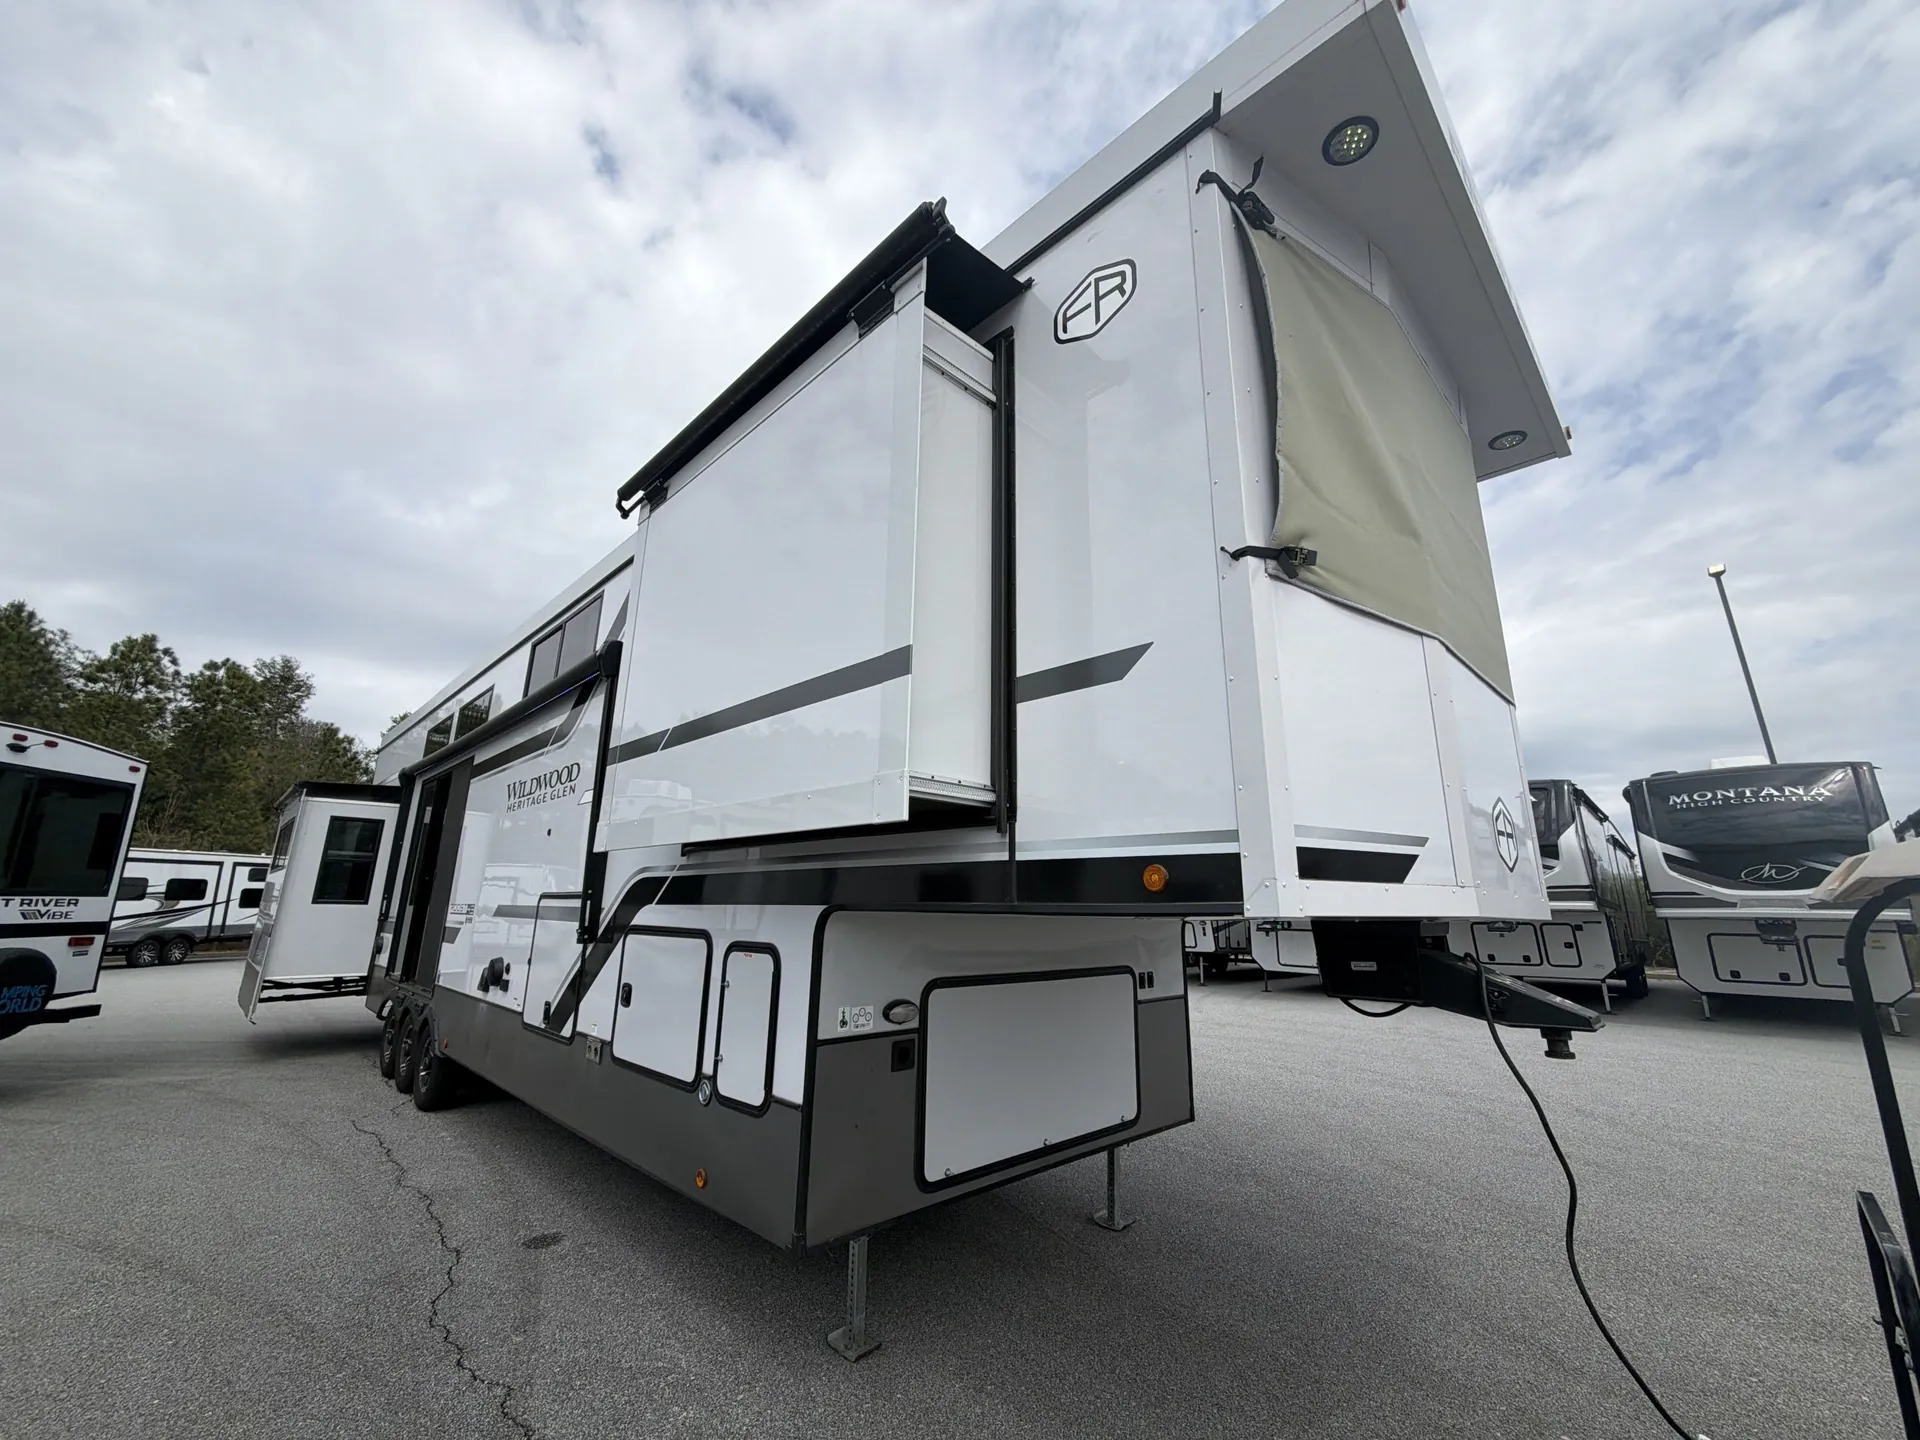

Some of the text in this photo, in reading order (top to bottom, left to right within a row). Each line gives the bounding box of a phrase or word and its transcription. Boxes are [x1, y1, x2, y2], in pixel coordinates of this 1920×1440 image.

[507, 763, 581, 802] WILDWOOD
[506, 783, 577, 813] HERITAGE GLEN
[1668, 785, 1834, 805] MONTANA
[1676, 796, 1826, 809] HIGH COUNTRY
[19, 898, 79, 907] RIVER
